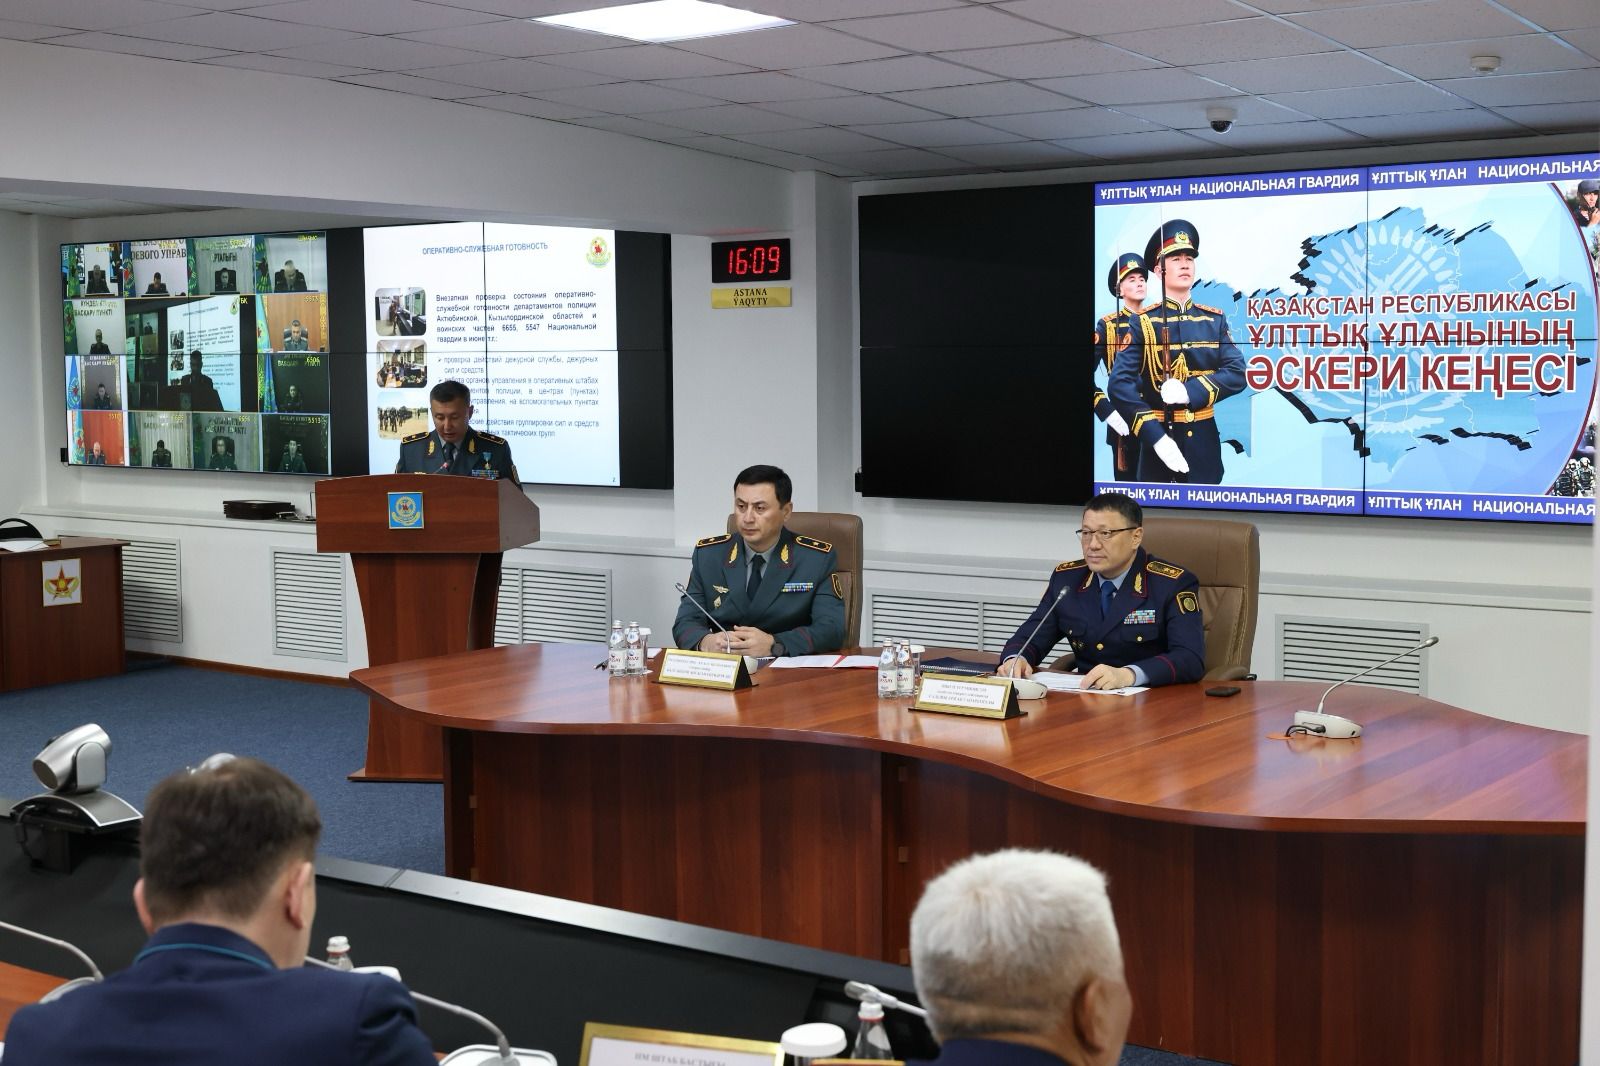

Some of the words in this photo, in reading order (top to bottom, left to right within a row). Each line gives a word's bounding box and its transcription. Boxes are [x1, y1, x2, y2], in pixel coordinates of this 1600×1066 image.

[1372, 170, 1427, 184] ҰЛТТЫҚ
[1430, 168, 1467, 180] ҰЛАН
[1478, 160, 1600, 178] НАЦИОНАЛЬНАЯ
[1100, 187, 1148, 200] ҰЛТТЫҚ
[1150, 184, 1181, 197] ҰЛАН
[1190, 177, 1295, 195] НАЦИОНАЛЬНАЯ
[1300, 174, 1359, 189] ГВАРДИЯ
[422, 244, 504, 255] ОПЕРАТИВНО-СЛУЖЕБНАЯ
[506, 242, 548, 251] ГОТОВНОСТЬ
[728, 246, 780, 274] 16:09
[436, 294, 468, 302] Внезапная
[476, 294, 506, 302] проверка
[514, 292, 546, 300] состояния
[554, 291, 596, 299] оперативно-
[734, 288, 768, 296] ASTANA
[436, 304, 470, 314] служебной
[514, 302, 562, 311] департаментов
[568, 302, 596, 310] полиции
[1248, 296, 1374, 319] ҚАЗАҚСТАН
[1382, 292, 1576, 313] РЕСПУБЛИКАСЫ
[436, 314, 480, 322] Актюбинской,
[488, 312, 544, 322] Кызылординской
[552, 312, 584, 320] областей
[473, 324, 494, 332] частей
[526, 323, 540, 331] 5547
[548, 322, 596, 331] Национальной
[437, 336, 462, 344] гвардии
[1248, 323, 1369, 352] ҰЛТТЫҚ
[1379, 320, 1574, 350] ҰЛАНЫНЫҢ
[474, 356, 502, 364] действий
[505, 356, 534, 365] дежурной
[566, 356, 598, 364] дежурных
[492, 378, 526, 386] управления
[534, 377, 574, 385] оперативных
[576, 376, 598, 384] штабах
[1247, 356, 1406, 390] ӘСКЕРИ
[1422, 355, 1574, 398] КЕҢЕСІ
[538, 388, 564, 396] центрах
[570, 387, 598, 397] (пунктах)
[574, 399, 598, 407] пунктах
[516, 420, 554, 428] группировки
[574, 420, 600, 428] средств
[538, 430, 556, 438] групп
[1148, 488, 1180, 500] ҰЛАН
[1188, 490, 1292, 505] НАЦИОНАЛЬНАЯ
[1296, 493, 1355, 508] ГВАРДИЯ
[1368, 496, 1422, 511] ҰЛТТЫҚ
[1426, 498, 1462, 511] ҰЛАН
[1473, 500, 1596, 516] НАЦИОНАЛЬНАЯ
